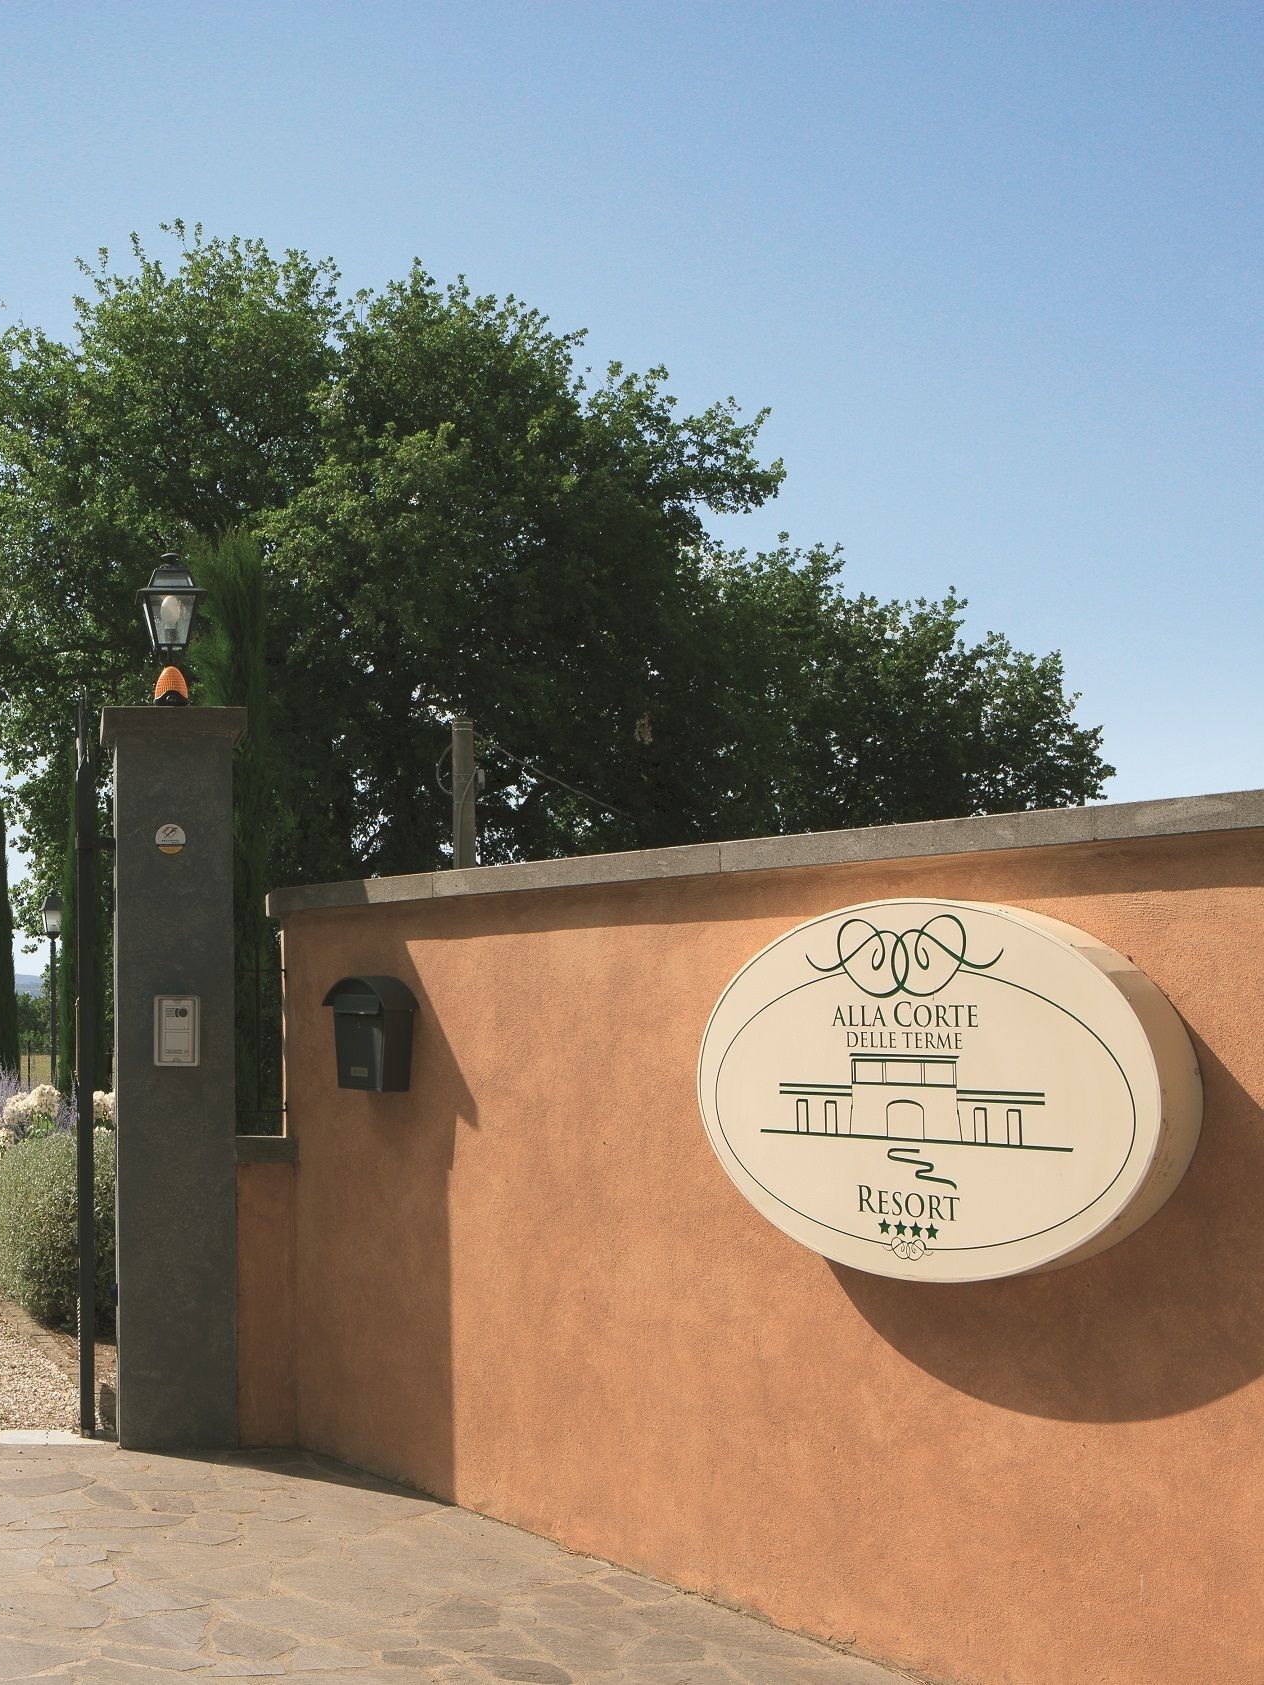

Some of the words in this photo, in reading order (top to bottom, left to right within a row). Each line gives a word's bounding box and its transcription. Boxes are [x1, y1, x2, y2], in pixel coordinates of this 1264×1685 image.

[832, 1004, 887, 1028] ALLA
[893, 1001, 979, 1029] CORTE
[845, 1031, 897, 1049] DELLE
[903, 1032, 963, 1050] TERME
[857, 1185, 961, 1222] RESORT
